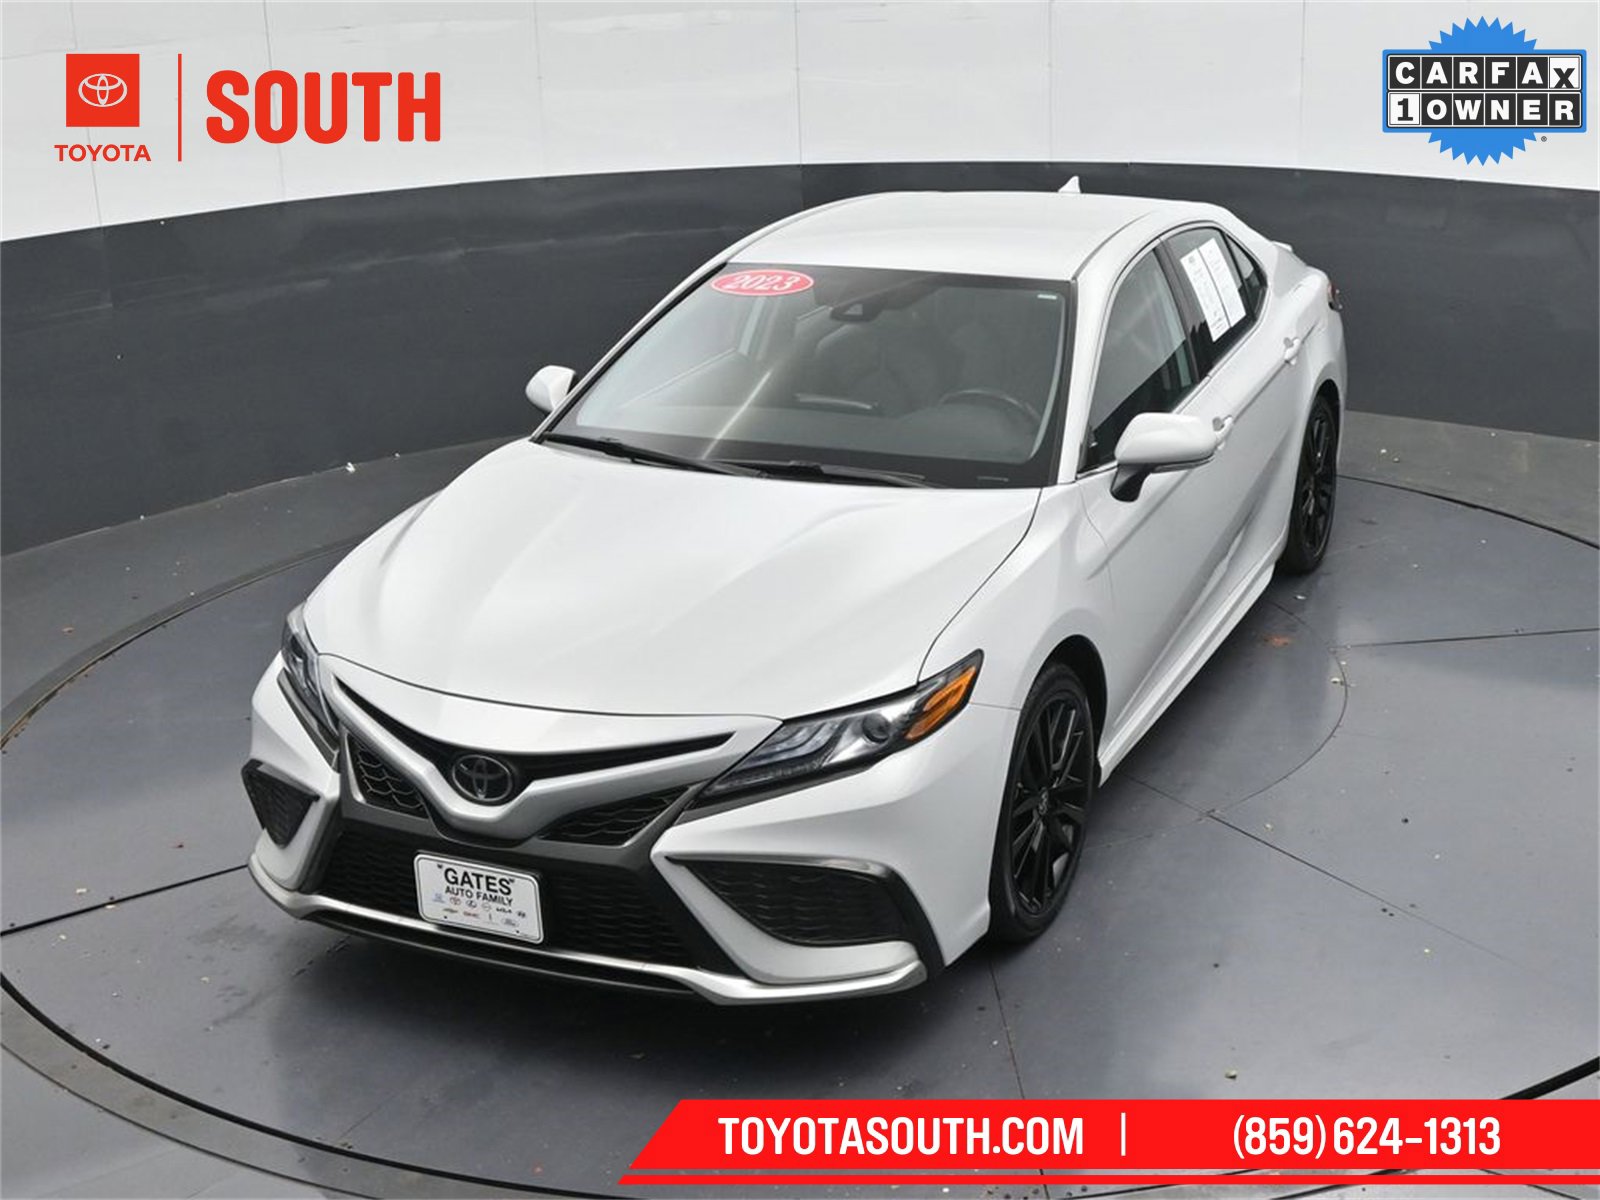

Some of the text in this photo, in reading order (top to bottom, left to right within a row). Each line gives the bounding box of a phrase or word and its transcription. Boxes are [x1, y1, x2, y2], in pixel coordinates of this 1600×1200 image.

[721, 273, 801, 291] 2023
[445, 886, 473, 899] AUTO
[476, 891, 513, 907] FAMILY
